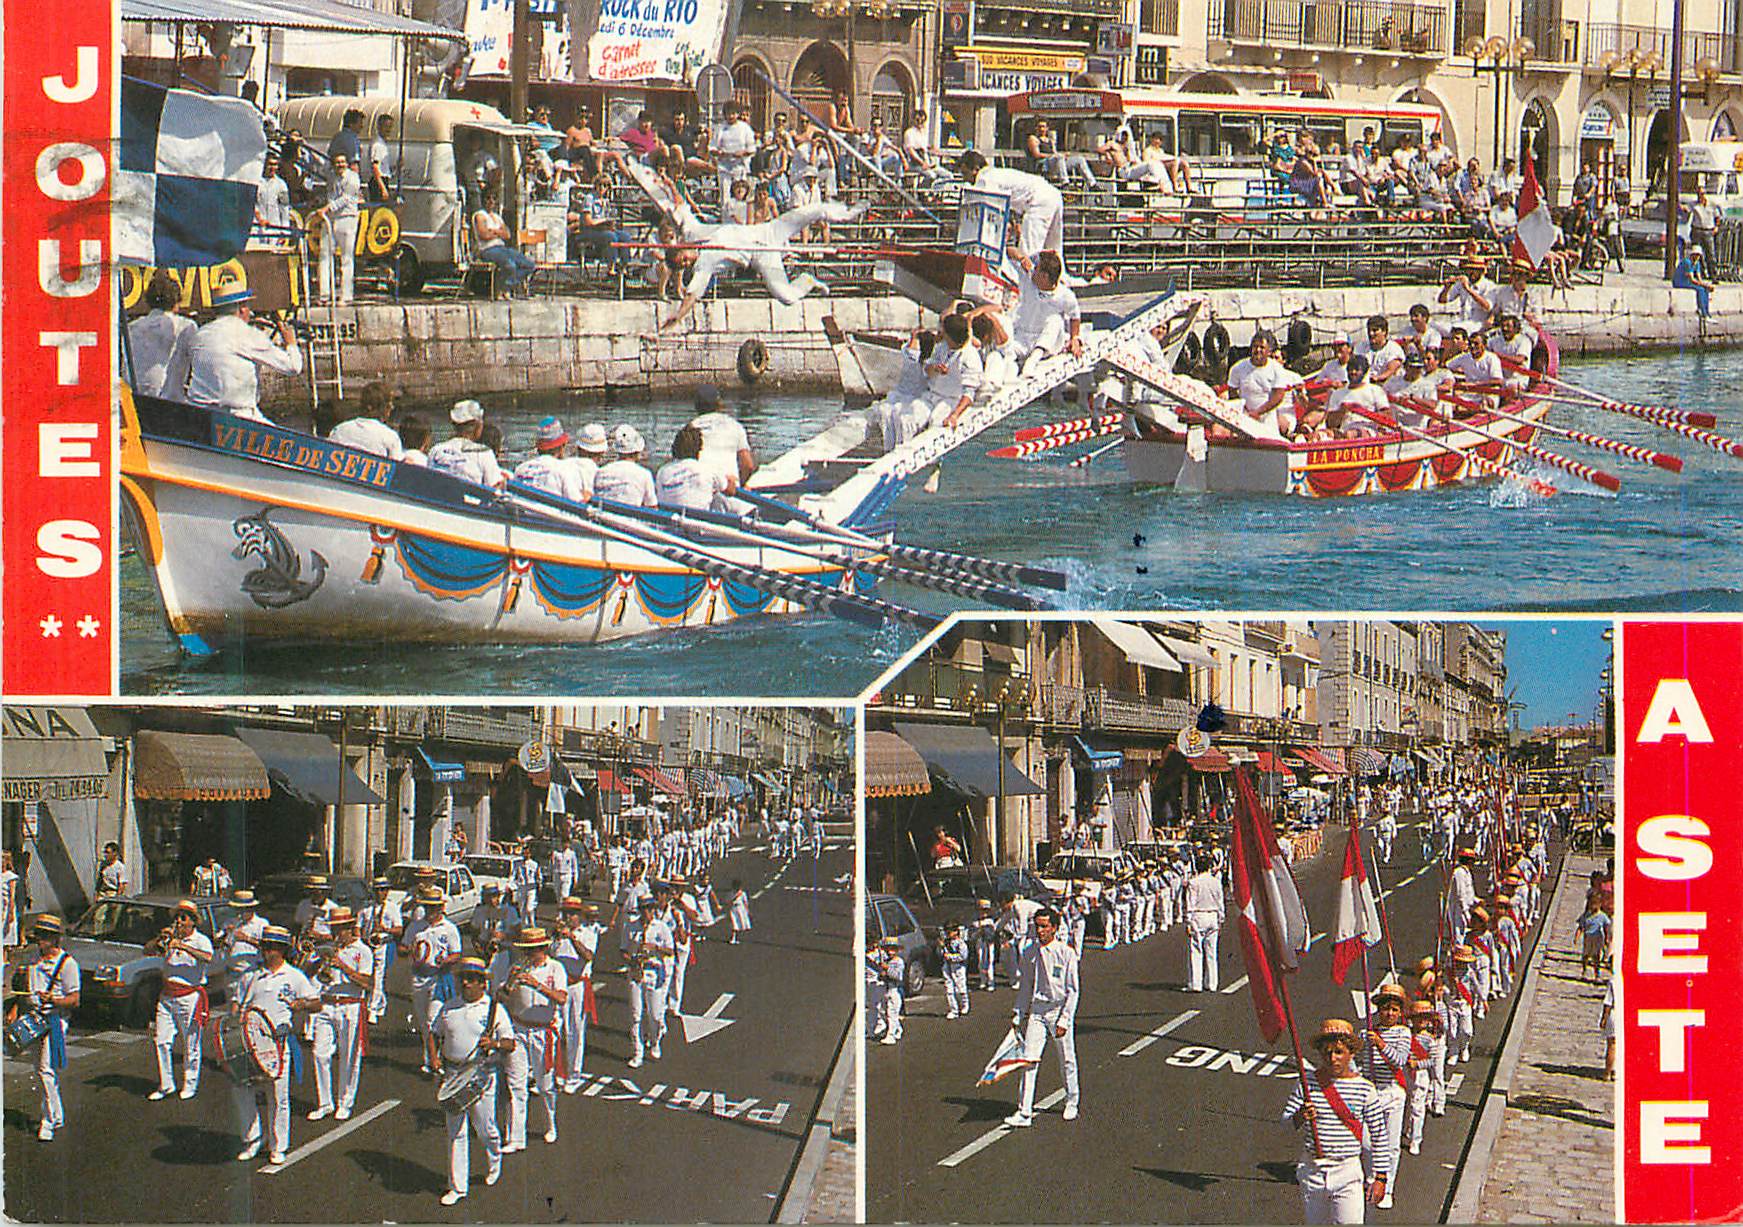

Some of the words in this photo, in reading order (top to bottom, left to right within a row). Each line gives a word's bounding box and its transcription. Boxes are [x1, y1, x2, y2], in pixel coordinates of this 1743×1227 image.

[643, 0, 659, 21] du
[664, 0, 698, 24] RIO
[618, 22, 625, 36] 6
[214, 424, 295, 463] VILLE
[294, 447, 324, 470] DE
[325, 450, 392, 487] SETE
[1313, 450, 1328, 464] LA
[1335, 446, 1380, 463] PONCHA
[2, 708, 80, 736] NA
